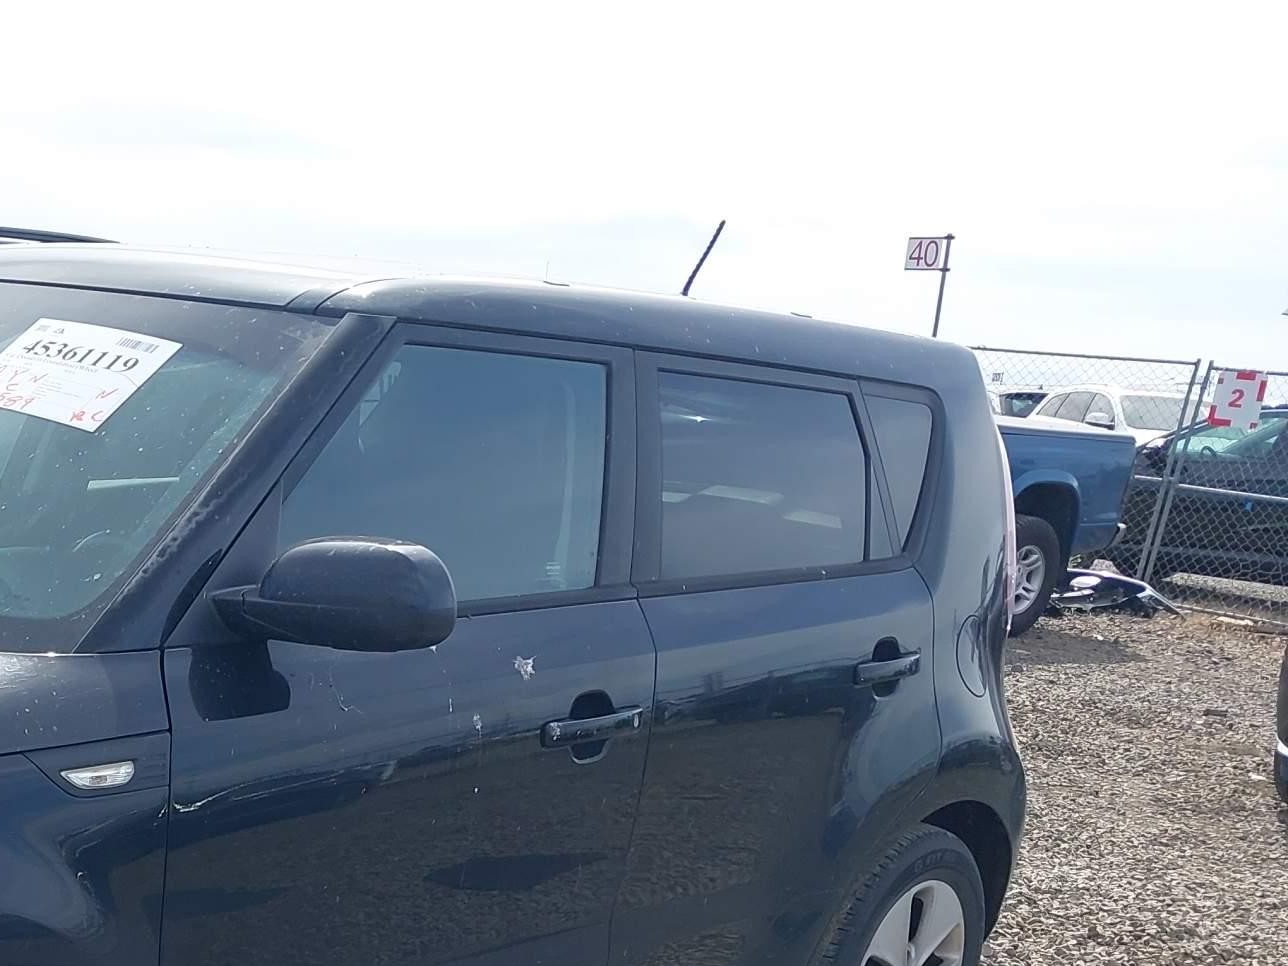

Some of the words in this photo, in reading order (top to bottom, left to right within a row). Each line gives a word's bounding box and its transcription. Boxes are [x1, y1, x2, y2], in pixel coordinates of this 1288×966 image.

[909, 240, 939, 267] 40
[23, 339, 139, 372] 45361119
[1228, 388, 1245, 408] 2
